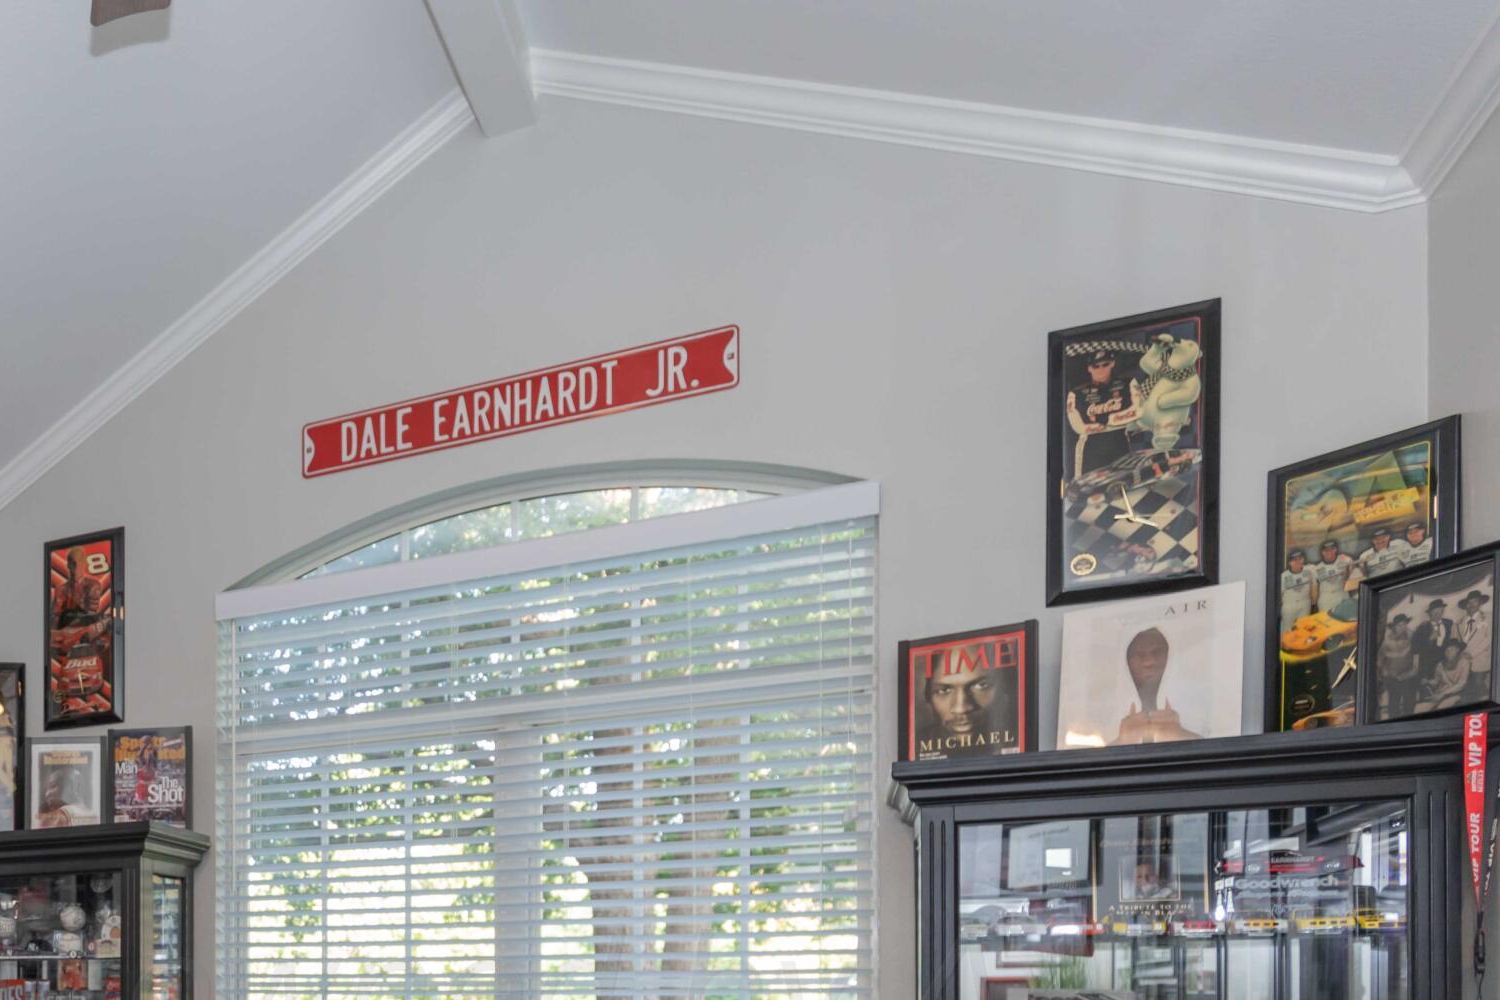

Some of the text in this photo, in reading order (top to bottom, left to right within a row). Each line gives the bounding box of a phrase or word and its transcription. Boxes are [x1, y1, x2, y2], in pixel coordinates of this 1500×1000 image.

[340, 345, 700, 463] DALE EARNHARDT JR.
[86, 552, 110, 575] 8
[1163, 600, 1209, 617] AIR
[64, 656, 98, 671] Bud
[914, 639, 1019, 680] TIME
[920, 730, 1015, 752] MICHAEL
[1468, 742, 1483, 767] VIP
[115, 762, 138, 775] Man
[161, 776, 179, 789] The
[148, 784, 185, 804] Shot
[1469, 812, 1482, 853] TOUR
[1235, 874, 1339, 889] Goodwrench
